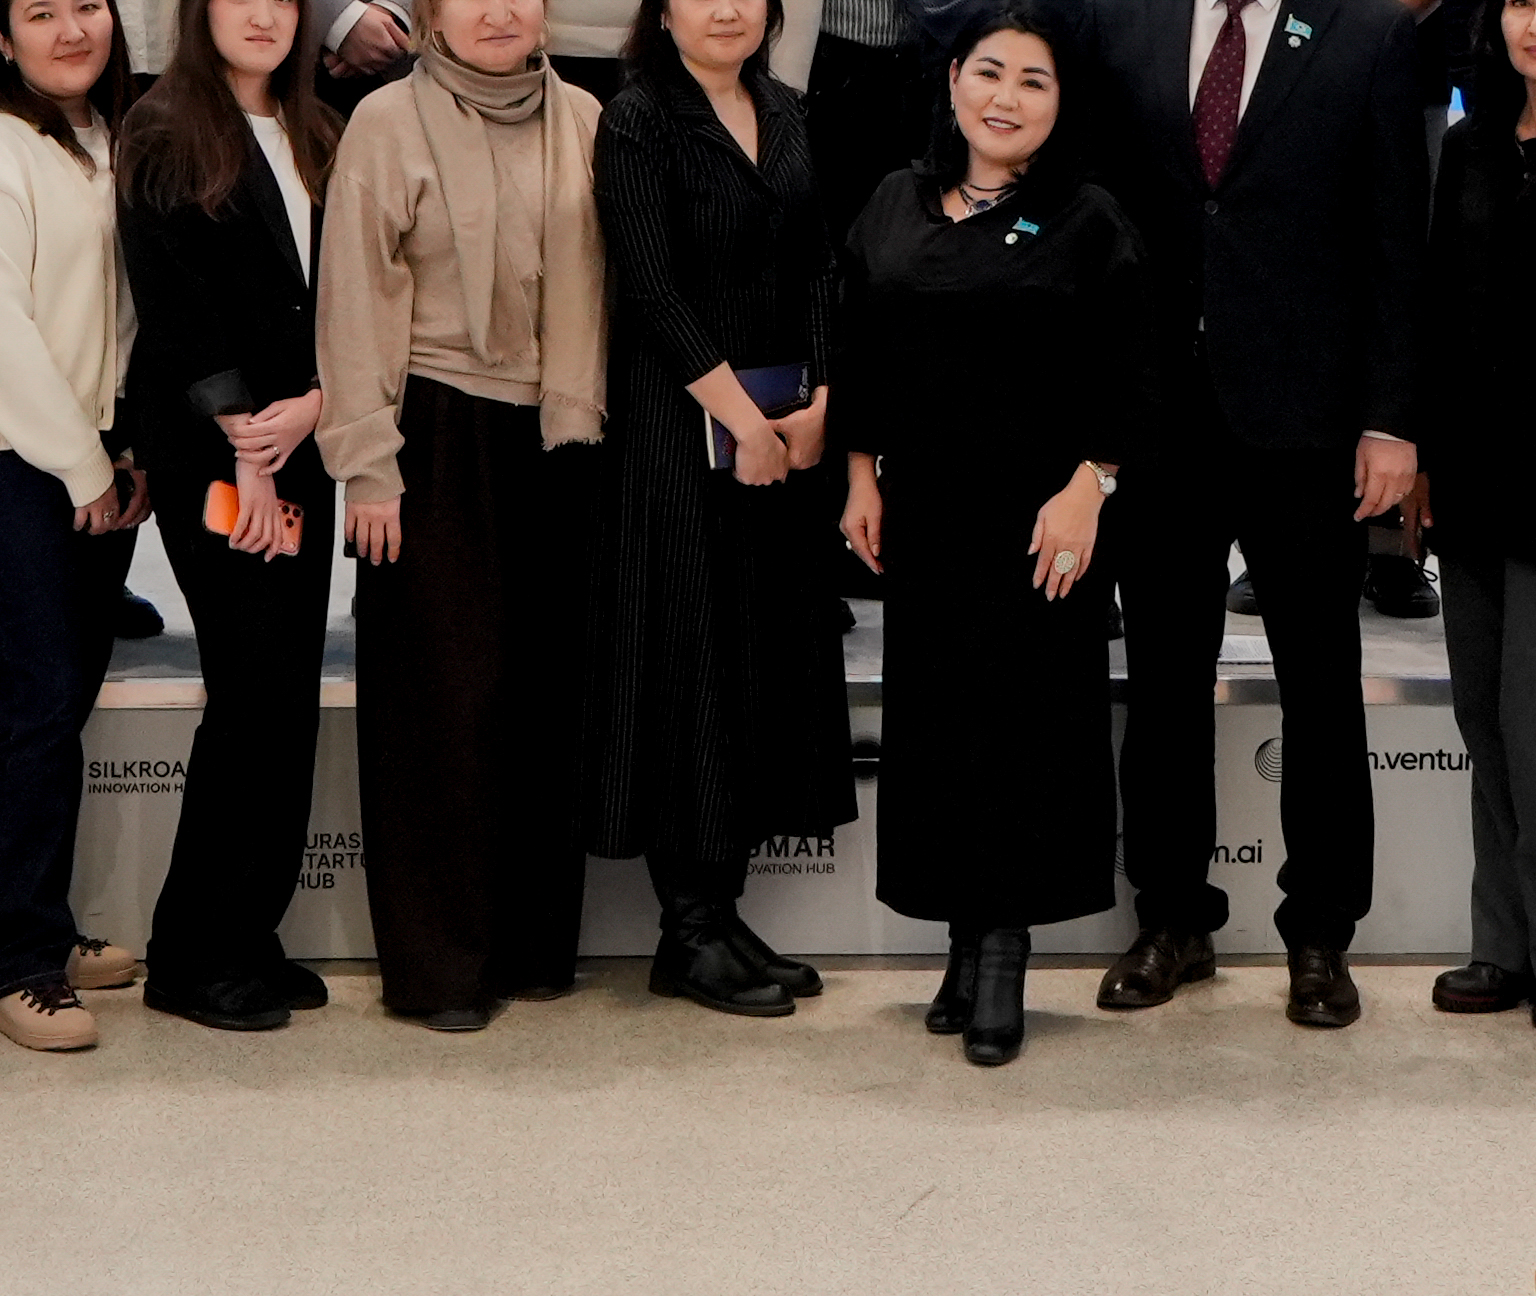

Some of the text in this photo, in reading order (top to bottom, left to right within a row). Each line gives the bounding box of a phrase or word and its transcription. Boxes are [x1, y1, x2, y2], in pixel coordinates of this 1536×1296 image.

[88, 761, 186, 779] SILKROA
[88, 783, 171, 794] INNOVATION
[746, 862, 835, 875] OVATION HUB
